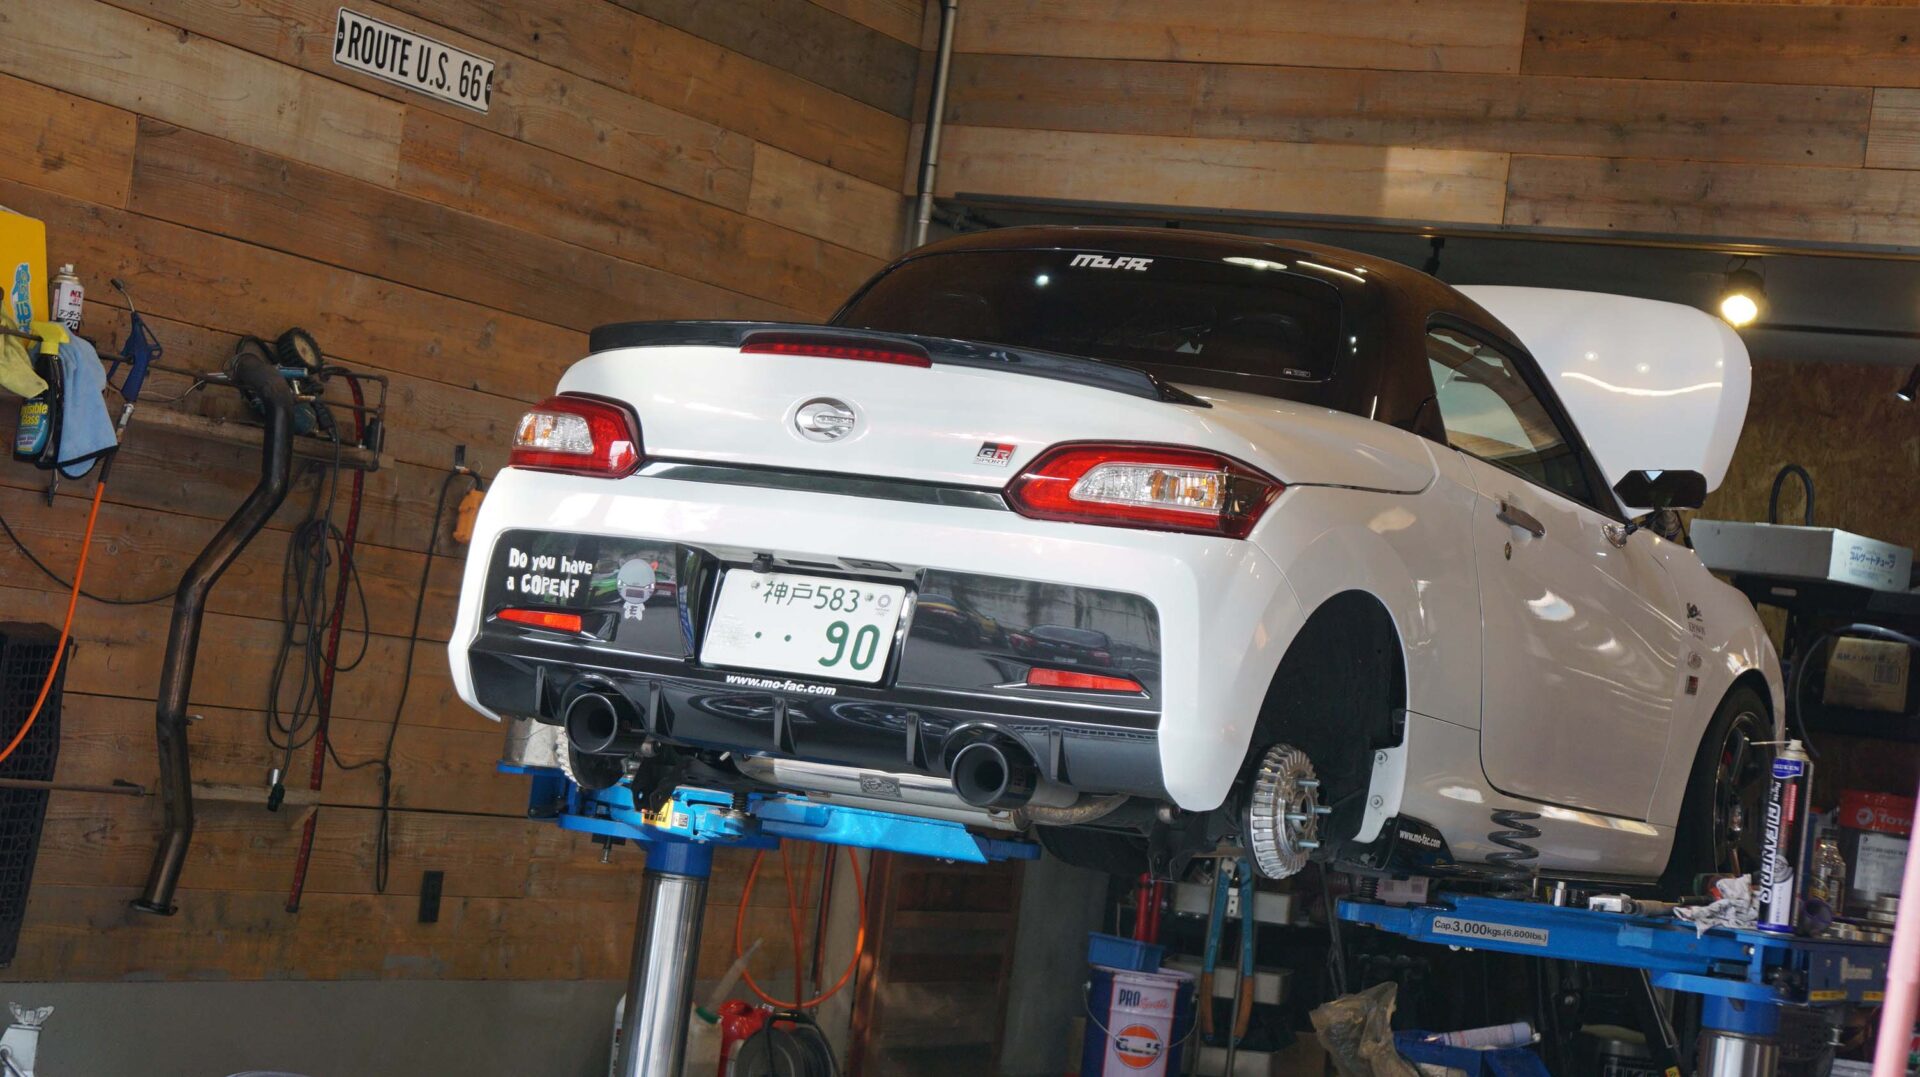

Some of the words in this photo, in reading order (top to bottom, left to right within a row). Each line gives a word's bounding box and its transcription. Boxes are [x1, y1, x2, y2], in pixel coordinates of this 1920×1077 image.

[348, 20, 412, 77] ROUTE
[416, 44, 451, 91] U.S.
[458, 60, 483, 101] 66
[980, 448, 1010, 459] GR
[508, 547, 528, 568] Do
[532, 555, 556, 571] you
[561, 556, 593, 575] have
[506, 576, 515, 591] a
[521, 573, 580, 598] COPEN?
[817, 620, 880, 670] 90
[726, 674, 837, 696] www.mo-fac.com
[1400, 829, 1441, 849] www.mo-fac.com
[1118, 988, 1141, 1007] PRO
